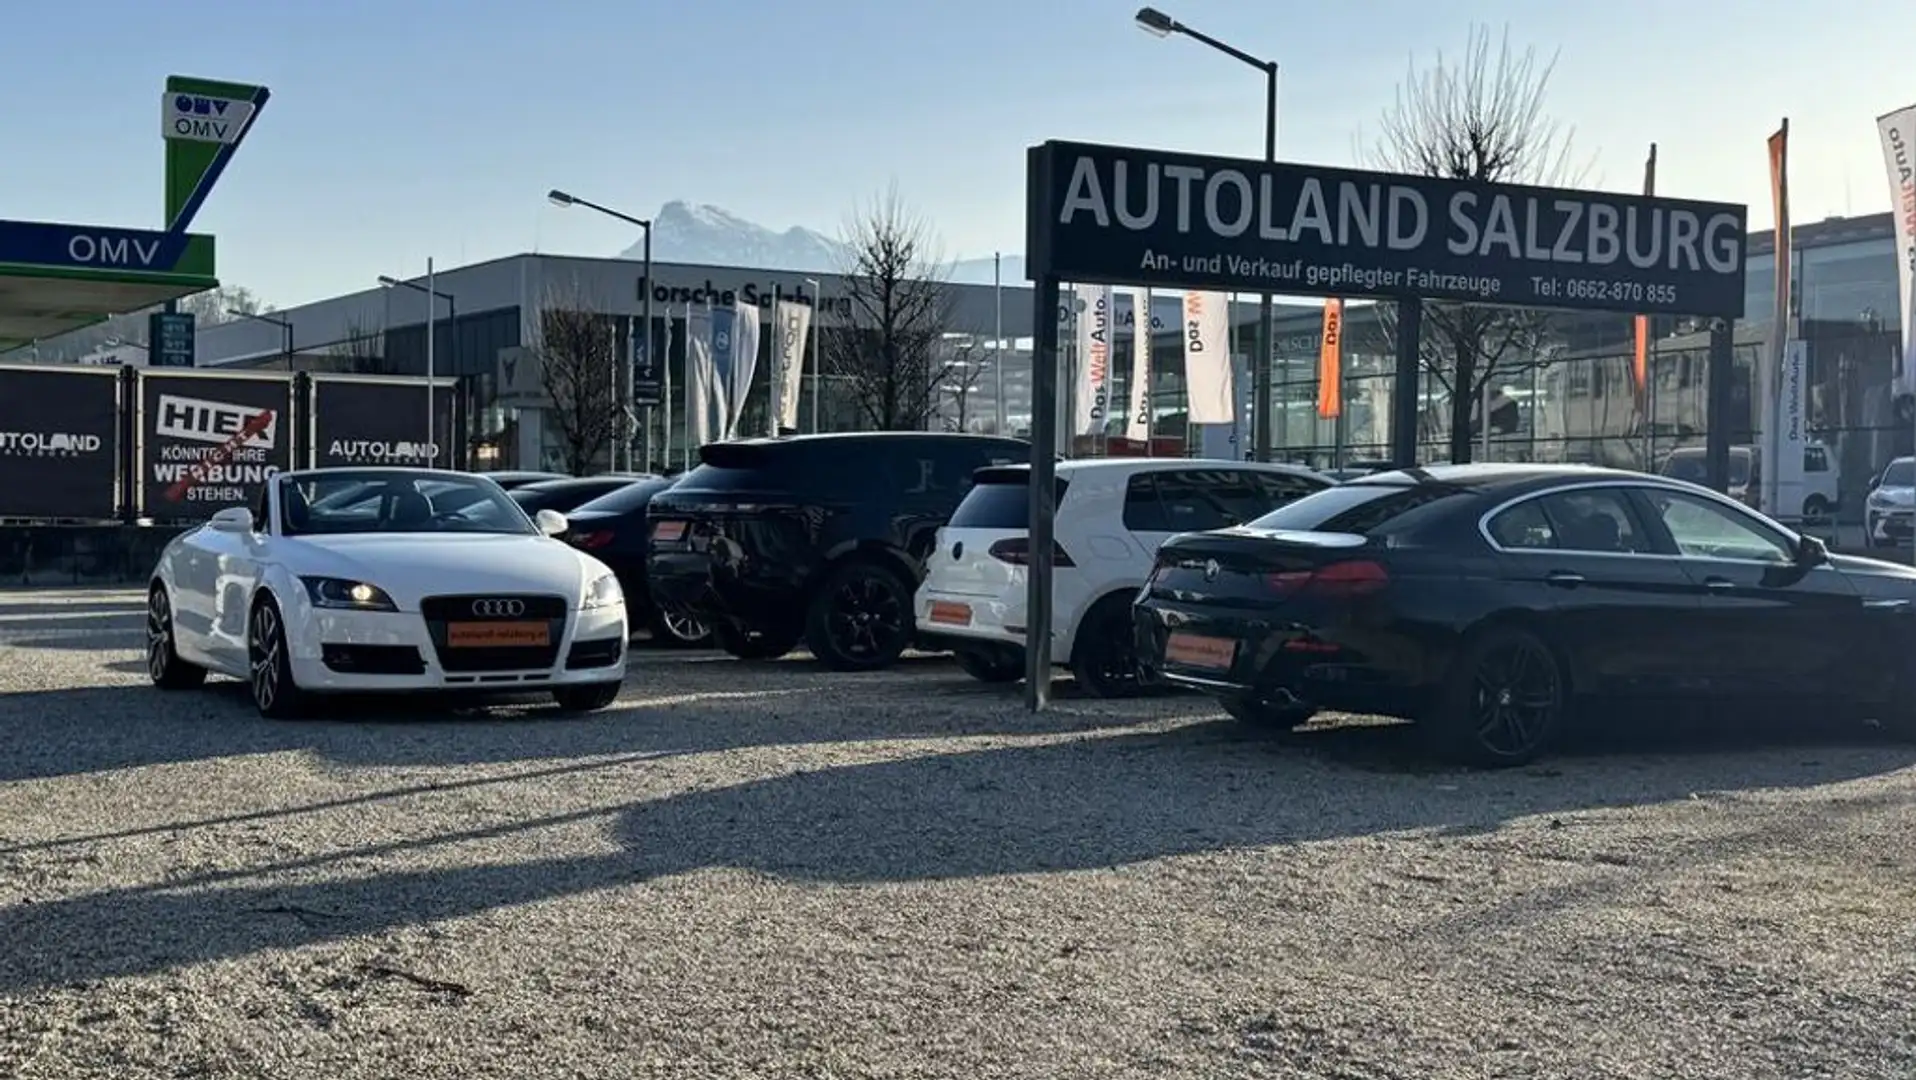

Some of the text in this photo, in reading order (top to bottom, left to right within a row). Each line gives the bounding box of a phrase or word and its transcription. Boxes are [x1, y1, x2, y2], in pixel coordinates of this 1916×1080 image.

[175, 118, 228, 139] OMV
[1059, 155, 1740, 274] AUTOLAND SALZBURG
[68, 234, 160, 266] OMV
[1139, 249, 1501, 297] An- und Verkauf gepflegter Fahrzeuge
[1530, 276, 1677, 304] Tel: 0662-870 855
[1090, 385, 1106, 419] Das
[163, 403, 270, 440] HIER
[0, 432, 100, 451] TOLAND
[232, 449, 266, 462] IHRE
[329, 440, 439, 458] AUTOLAND
